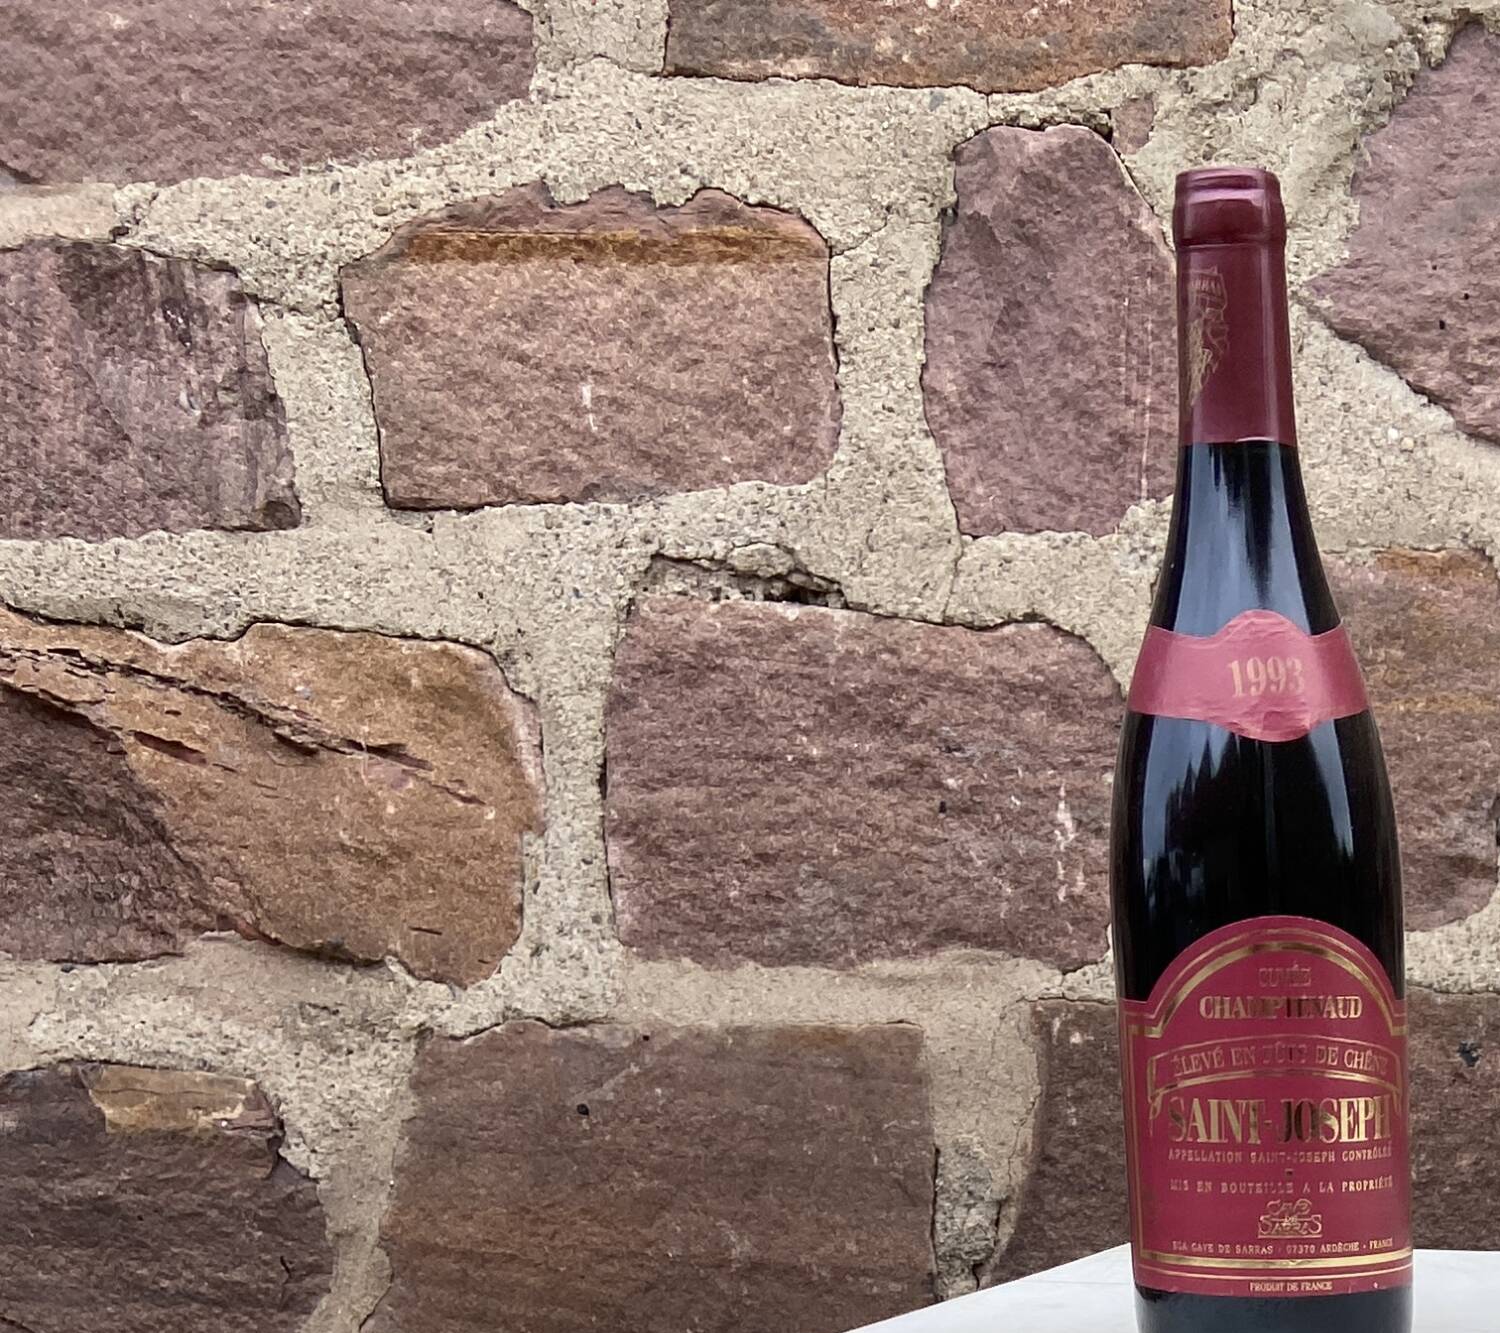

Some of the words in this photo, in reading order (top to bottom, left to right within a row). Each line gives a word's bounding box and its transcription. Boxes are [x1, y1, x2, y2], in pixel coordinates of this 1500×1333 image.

[1226, 656, 1304, 697] 1993
[1230, 1046, 1256, 1066] EN
[1316, 1044, 1339, 1066] DE
[1168, 1148, 1242, 1163] APPELLATION
[1197, 1181, 1212, 1193] EN
[1221, 1182, 1293, 1194] BOUTEILLE
[1319, 1181, 1334, 1194] LA
[1191, 1242, 1214, 1253] CAVE
[1218, 1244, 1231, 1254] DE
[1235, 1244, 1274, 1255] SARRAS
[1249, 1281, 1285, 1292] PRODUIT
[1286, 1281, 1299, 1292] DE
[1301, 1280, 1333, 1291] FRANCE
